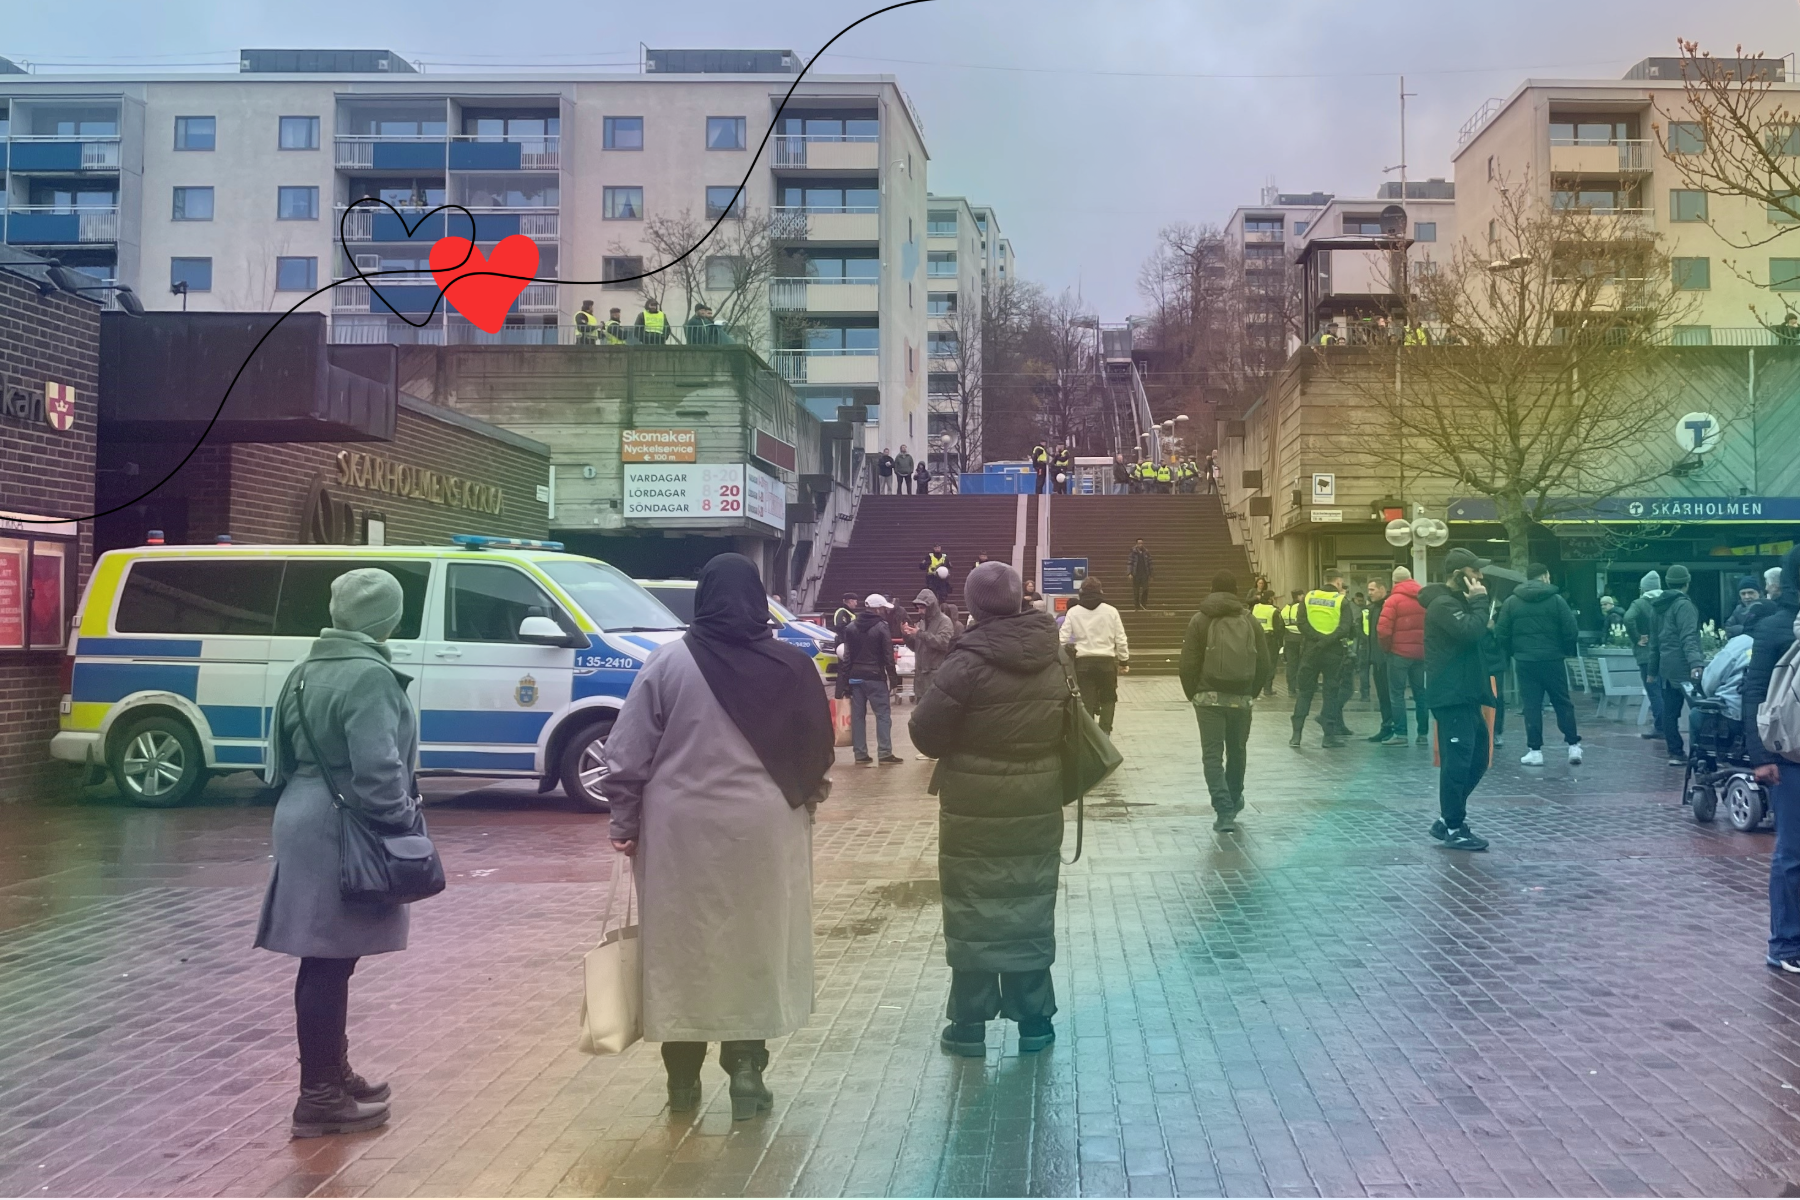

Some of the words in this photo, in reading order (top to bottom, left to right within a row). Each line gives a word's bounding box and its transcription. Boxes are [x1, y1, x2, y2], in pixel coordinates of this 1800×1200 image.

[622, 430, 695, 443] Skomakeri
[1684, 420, 1711, 447] T
[624, 444, 693, 454] Nyckelservice
[630, 474, 687, 482] VARDAGAR
[462, 481, 504, 515] KYRKA
[629, 487, 686, 497] LÖRDAGAR
[629, 502, 689, 512] SÖNDAGAR
[1652, 501, 1762, 515] SKÄRHOLMEN
[576, 656, 582, 666] 1
[586, 656, 633, 668] 35-2410
